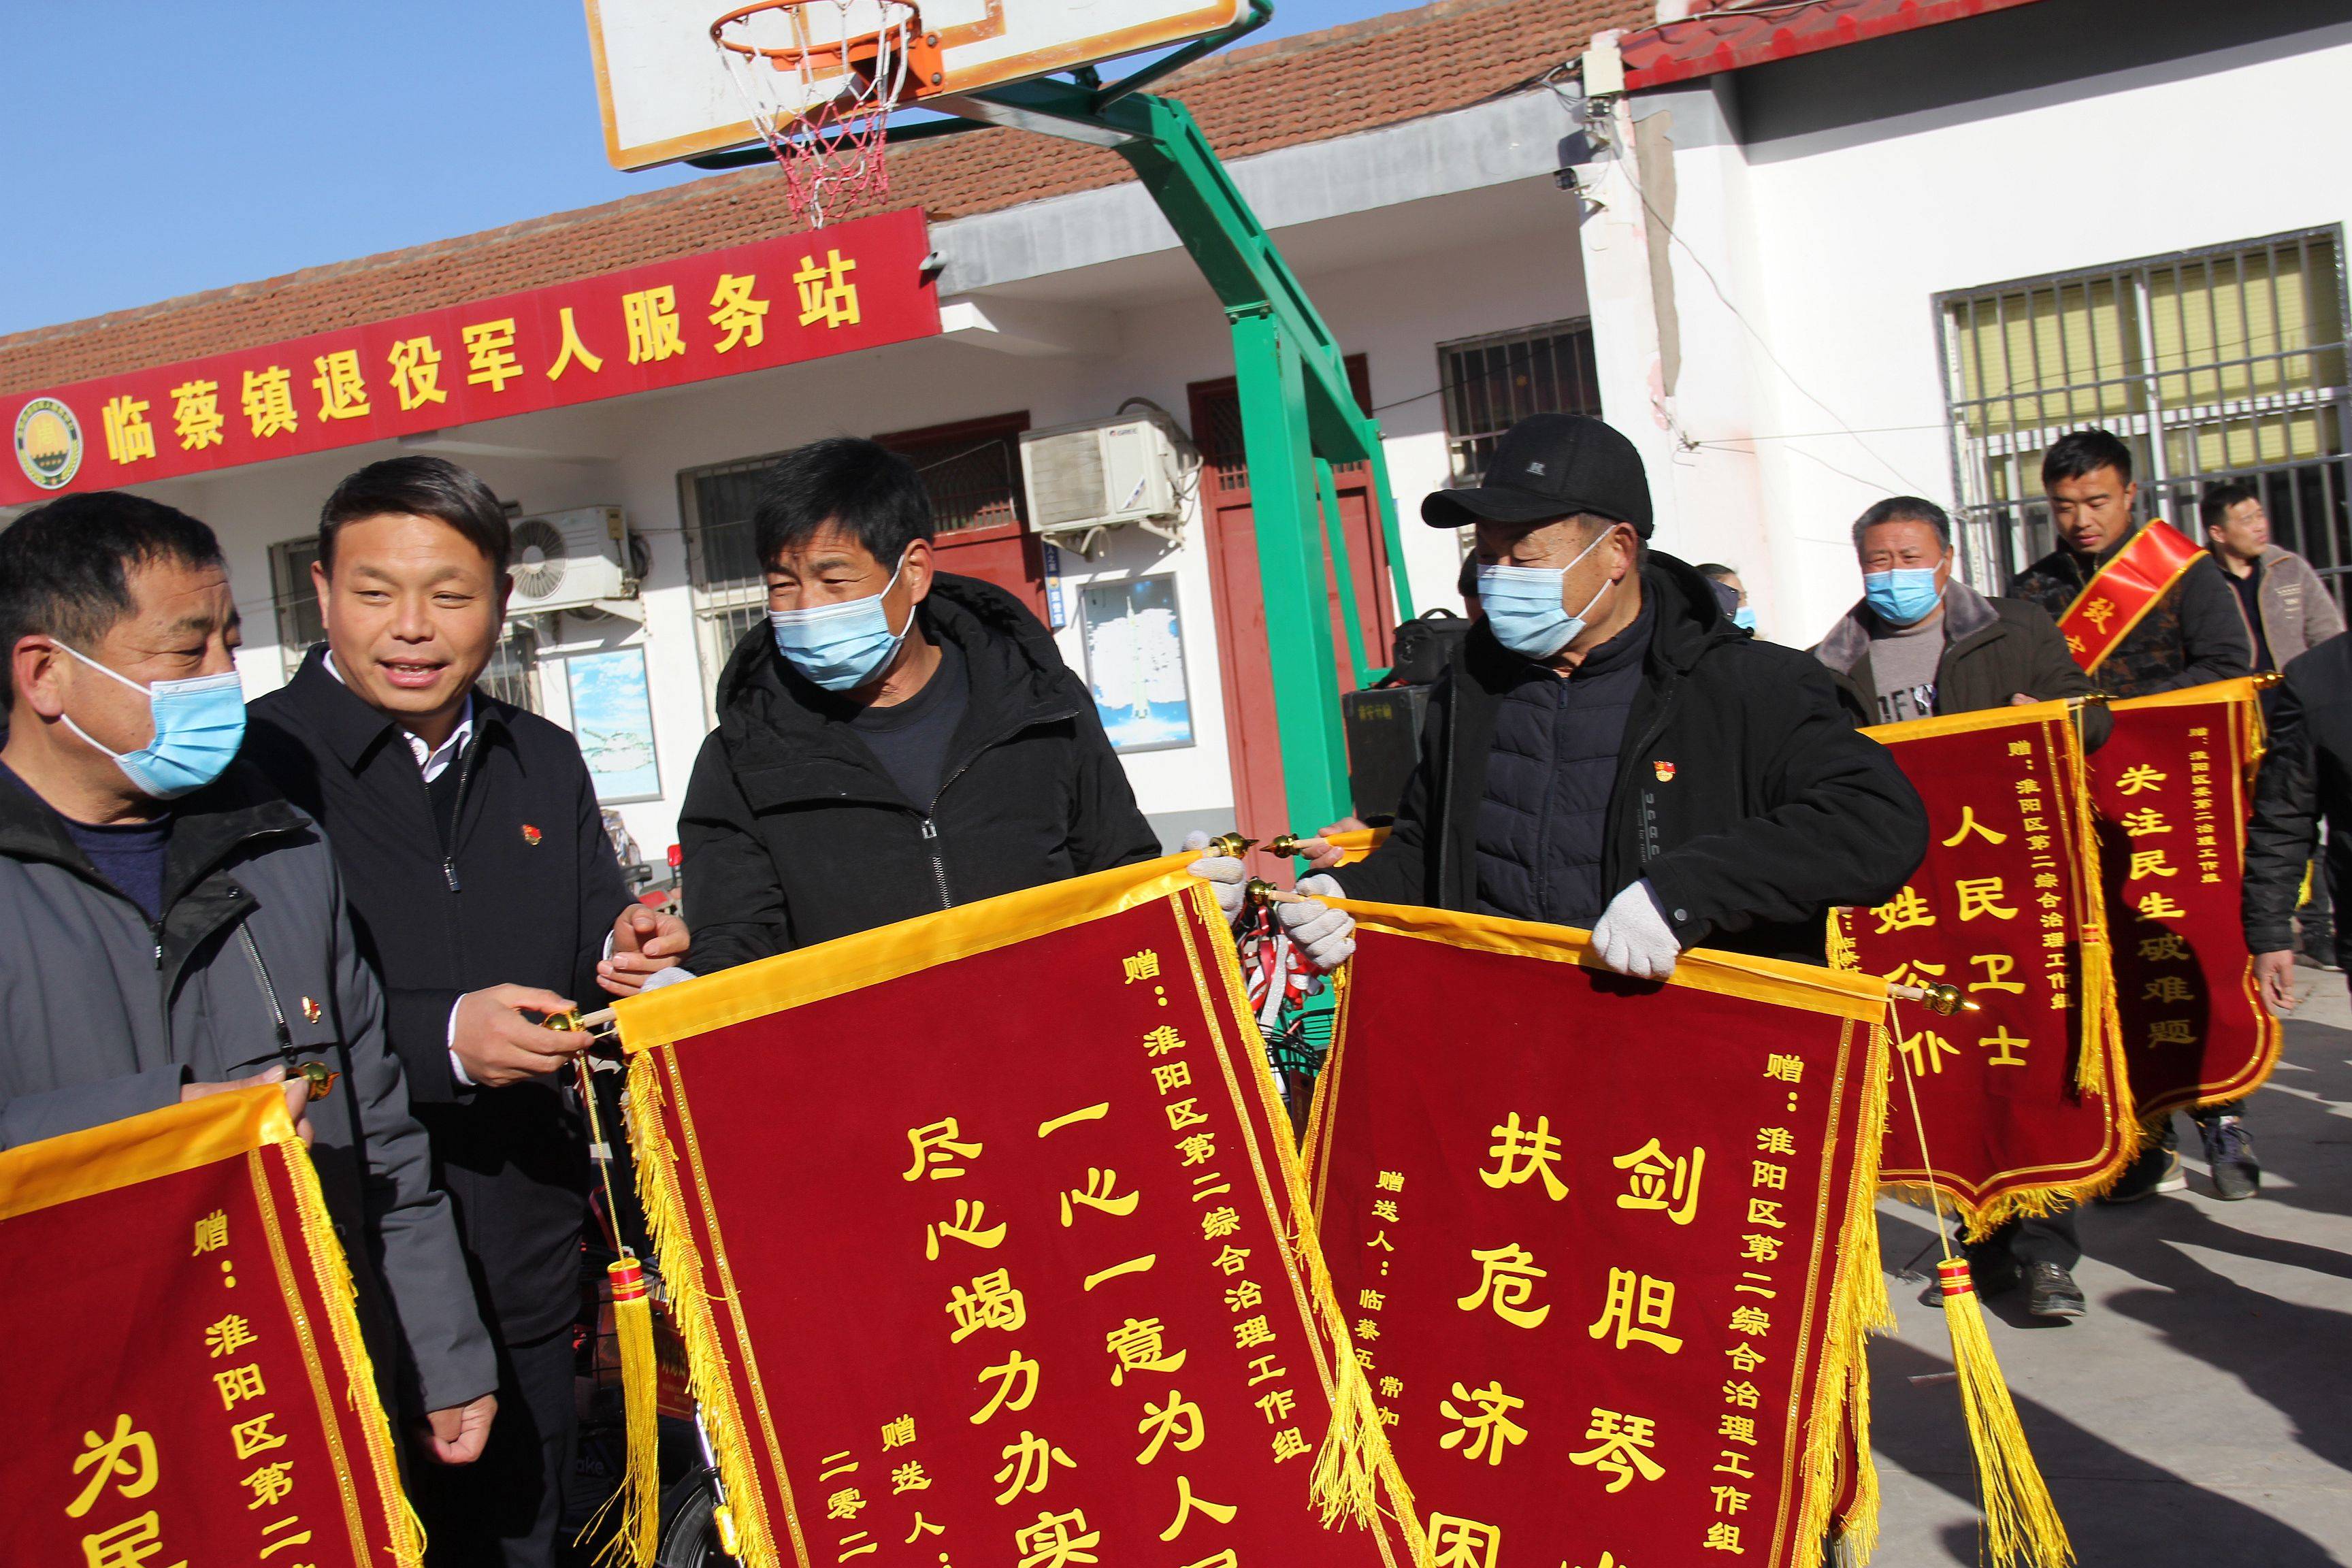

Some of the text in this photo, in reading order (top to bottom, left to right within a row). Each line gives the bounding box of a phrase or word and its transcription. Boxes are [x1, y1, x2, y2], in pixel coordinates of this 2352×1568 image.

[102, 249, 860, 466] 临蔡镇退役军人服务站
[1942, 806, 2030, 1066] 人民卫士
[2008, 740, 2074, 1010] 赠：淮阳区第二综合治理工作组
[2116, 764, 2197, 1048] 关注民生破难题
[902, 1117, 1100, 1568] 尽心竭力办实
[1038, 1102, 1238, 1568] 一心一意为人
[1122, 949, 1311, 1464] 赠：淮阳区第二综合治理工作组
[1428, 1112, 1569, 1568] 扶危济困
[1560, 1138, 1705, 1568] 剑胆琴
[1703, 1054, 1804, 1554] 赠：淮阳区第二综合治理工作组
[65, 1414, 188, 1568] 为民
[192, 1209, 315, 1568] 赠：淮阳区第二
[819, 1450, 878, 1563] 二零二
